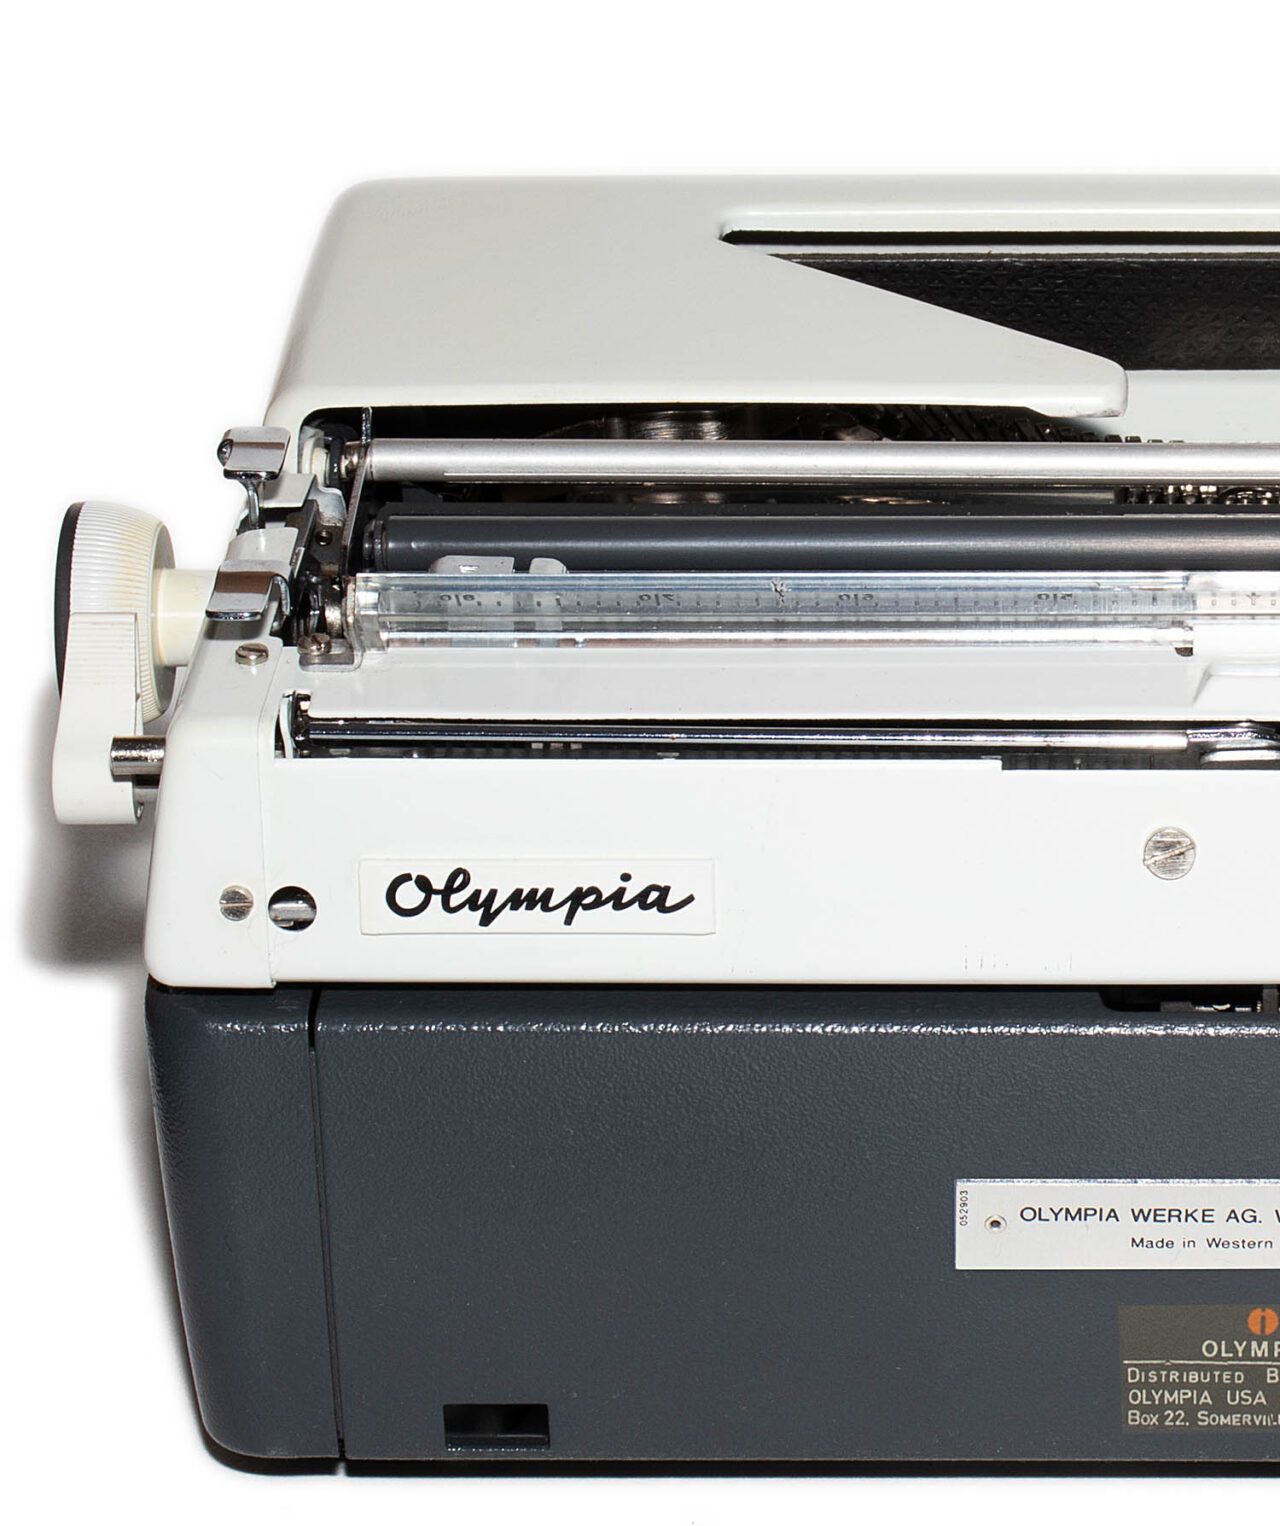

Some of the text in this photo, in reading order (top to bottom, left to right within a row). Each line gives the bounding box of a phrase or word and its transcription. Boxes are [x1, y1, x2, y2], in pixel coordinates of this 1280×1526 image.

[386, 867, 695, 927] Olympia
[959, 1190, 969, 1226] 052903
[1019, 1206, 1120, 1223] OLYMPIA
[1130, 1208, 1215, 1224] WERKE
[1225, 1208, 1263, 1224] AG.
[1131, 1237, 1175, 1249] Made
[1182, 1237, 1196, 1249] in
[1206, 1237, 1273, 1249] Western
[1128, 1389, 1213, 1405] OLYMPIA
[1226, 1389, 1267, 1406] USA
